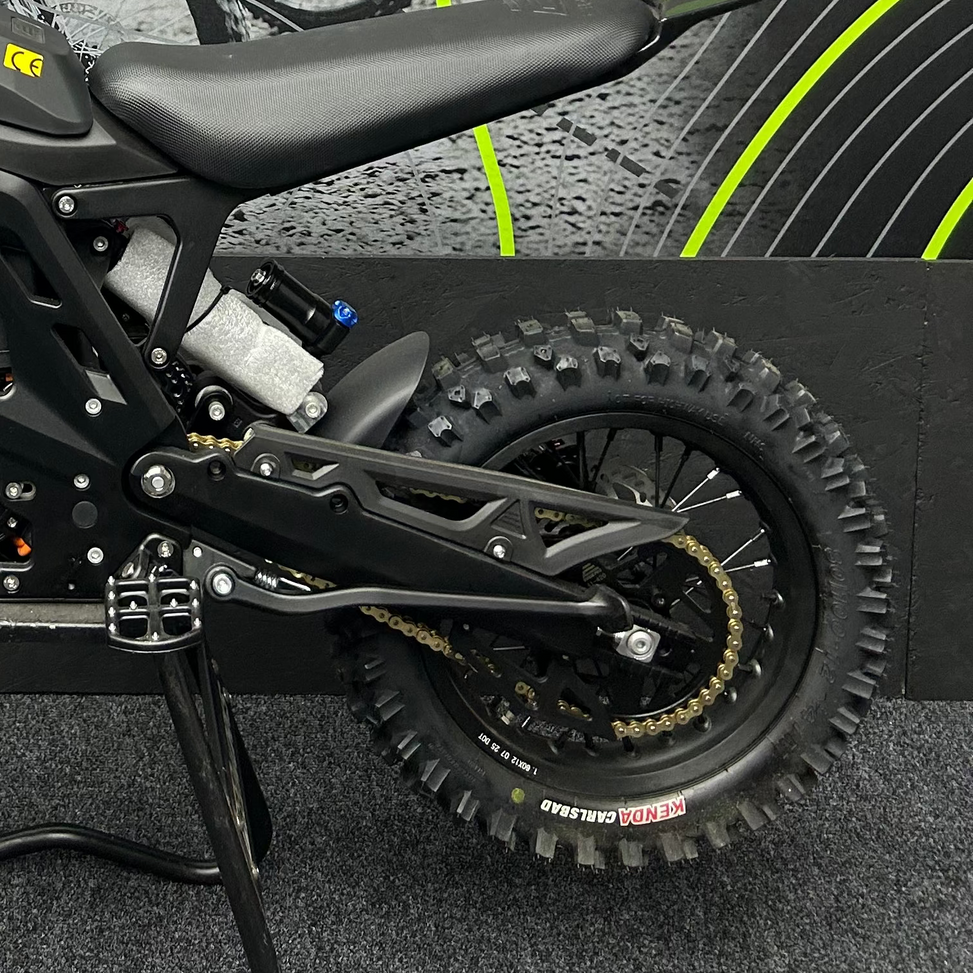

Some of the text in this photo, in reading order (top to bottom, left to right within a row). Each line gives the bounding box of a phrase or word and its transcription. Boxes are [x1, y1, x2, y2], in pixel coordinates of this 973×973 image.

[478, 732, 492, 745] DOT
[490, 741, 501, 753] 25
[500, 749, 511, 760] 07
[540, 796, 686, 826] KENDA CARLSBAD
